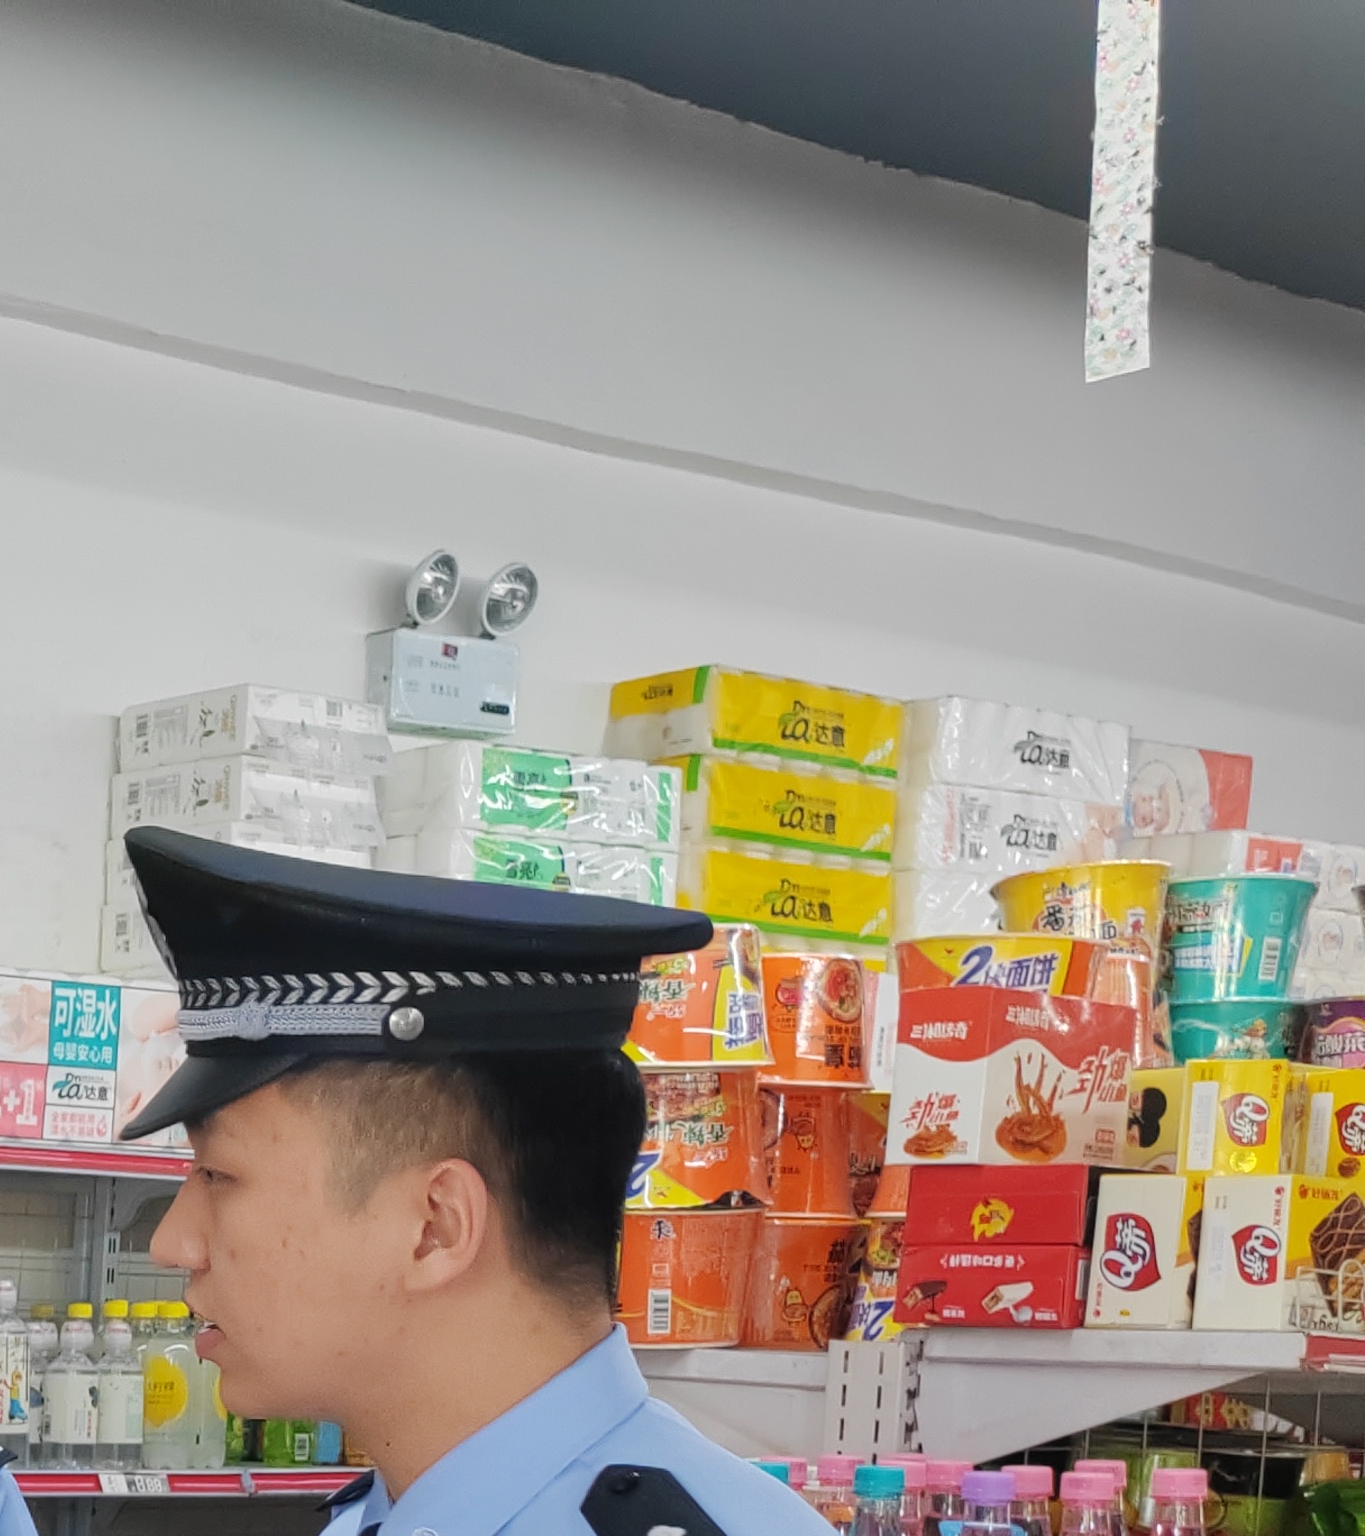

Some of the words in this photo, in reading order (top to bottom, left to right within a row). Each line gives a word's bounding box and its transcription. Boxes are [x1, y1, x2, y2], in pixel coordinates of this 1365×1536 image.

[54, 986, 117, 1041] 可湿水
[52, 1042, 114, 1065] 母婴安心用
